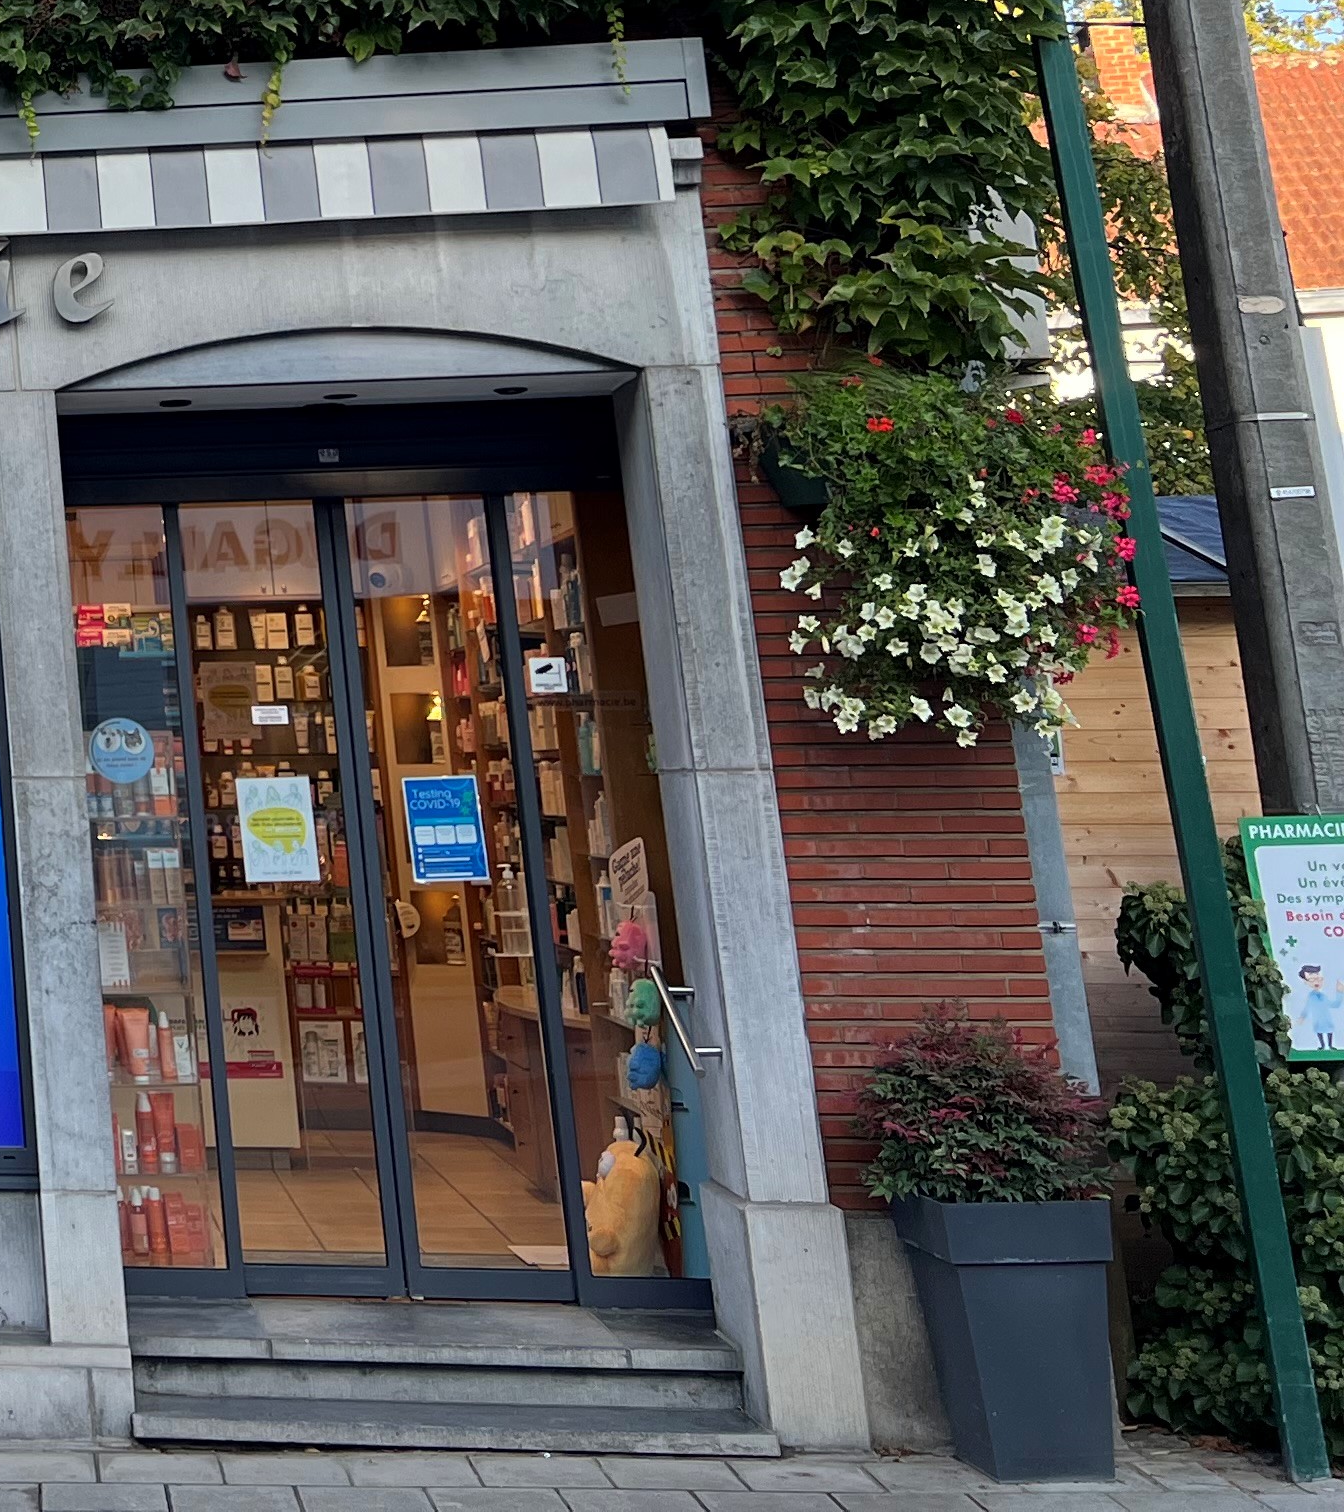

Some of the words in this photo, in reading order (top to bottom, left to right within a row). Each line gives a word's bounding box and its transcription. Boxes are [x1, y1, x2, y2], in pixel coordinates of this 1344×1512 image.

[411, 788, 452, 800] Testing
[409, 798, 461, 811] COVID-19
[1307, 860, 1327, 872] Un
[1297, 877, 1318, 889] Un
[1276, 893, 1302, 904] Des
[1285, 909, 1334, 922] Besoin
